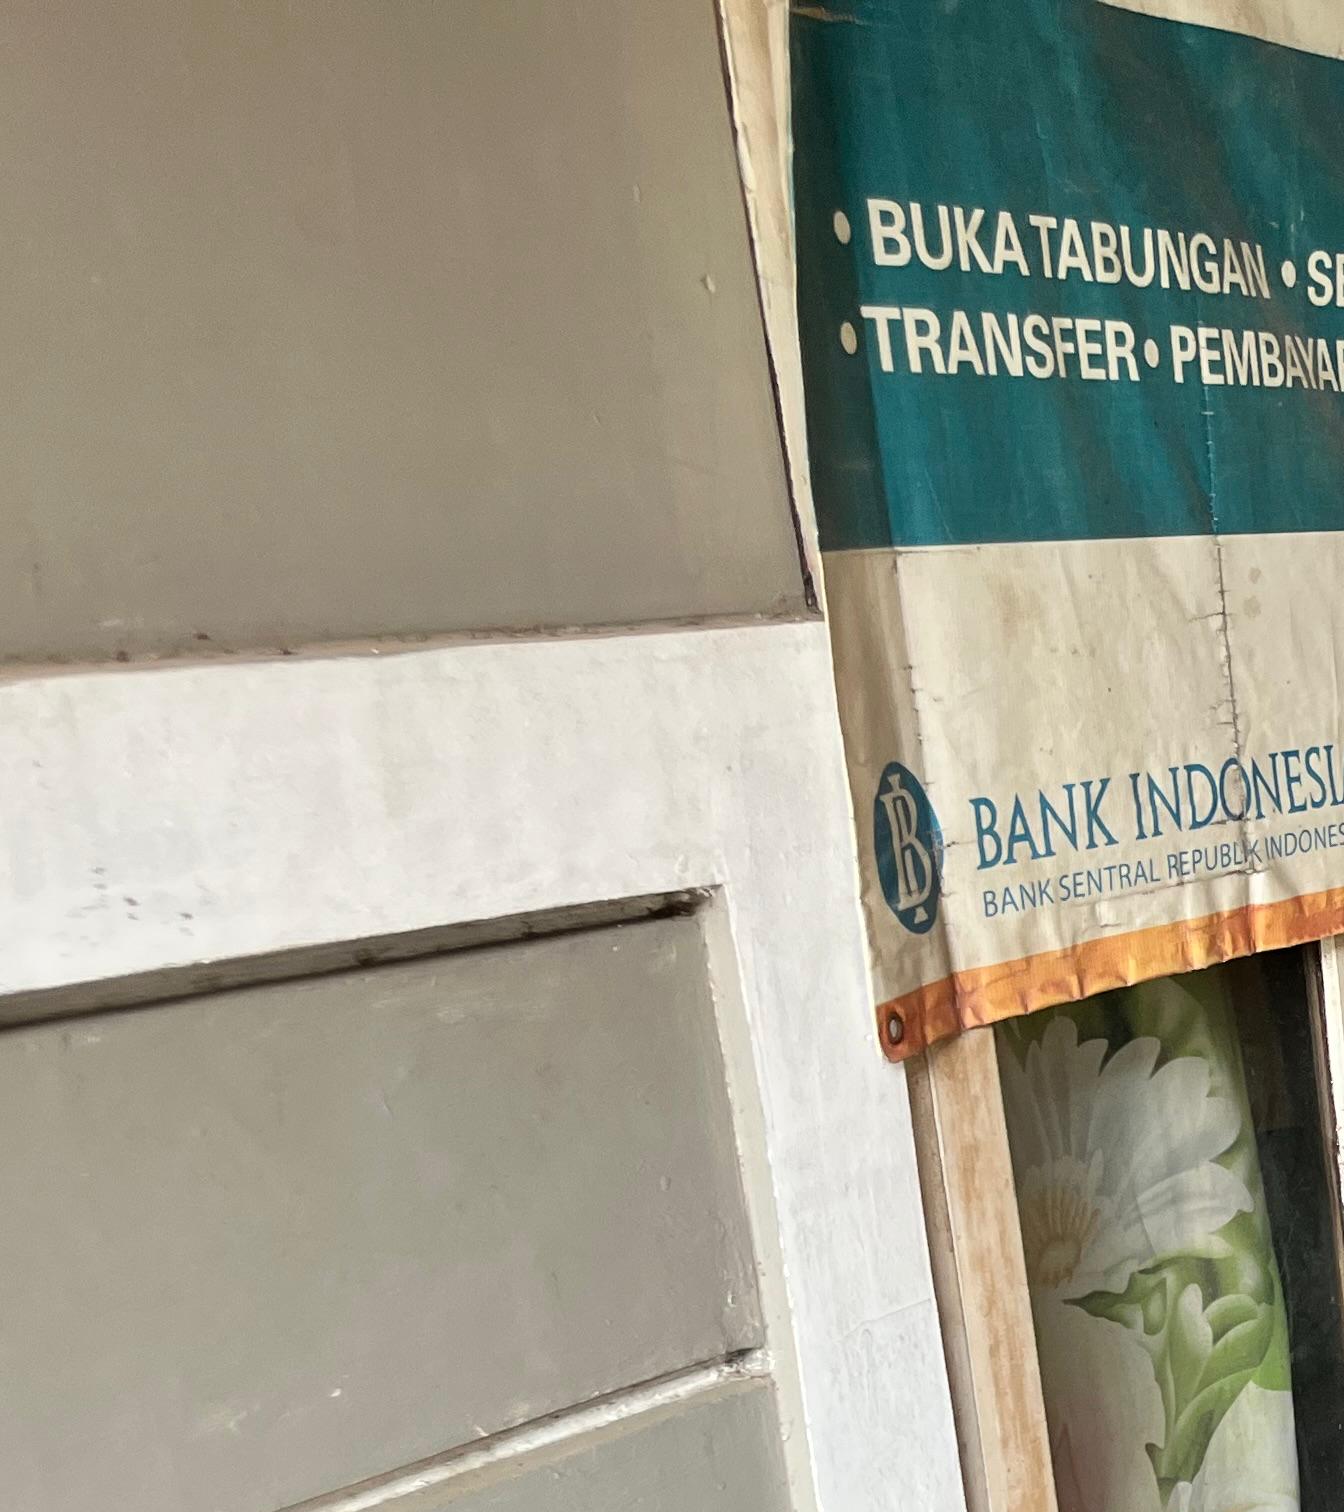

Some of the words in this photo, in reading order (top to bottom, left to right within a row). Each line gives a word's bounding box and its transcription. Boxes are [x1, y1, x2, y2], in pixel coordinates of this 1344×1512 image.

[861, 305, 1140, 384] TRANSFER
[969, 776, 1119, 870] BANK
[983, 878, 1055, 918] BANK
[1060, 859, 1161, 903] SENTRAL
[1167, 839, 1264, 879] REPUBLIK
